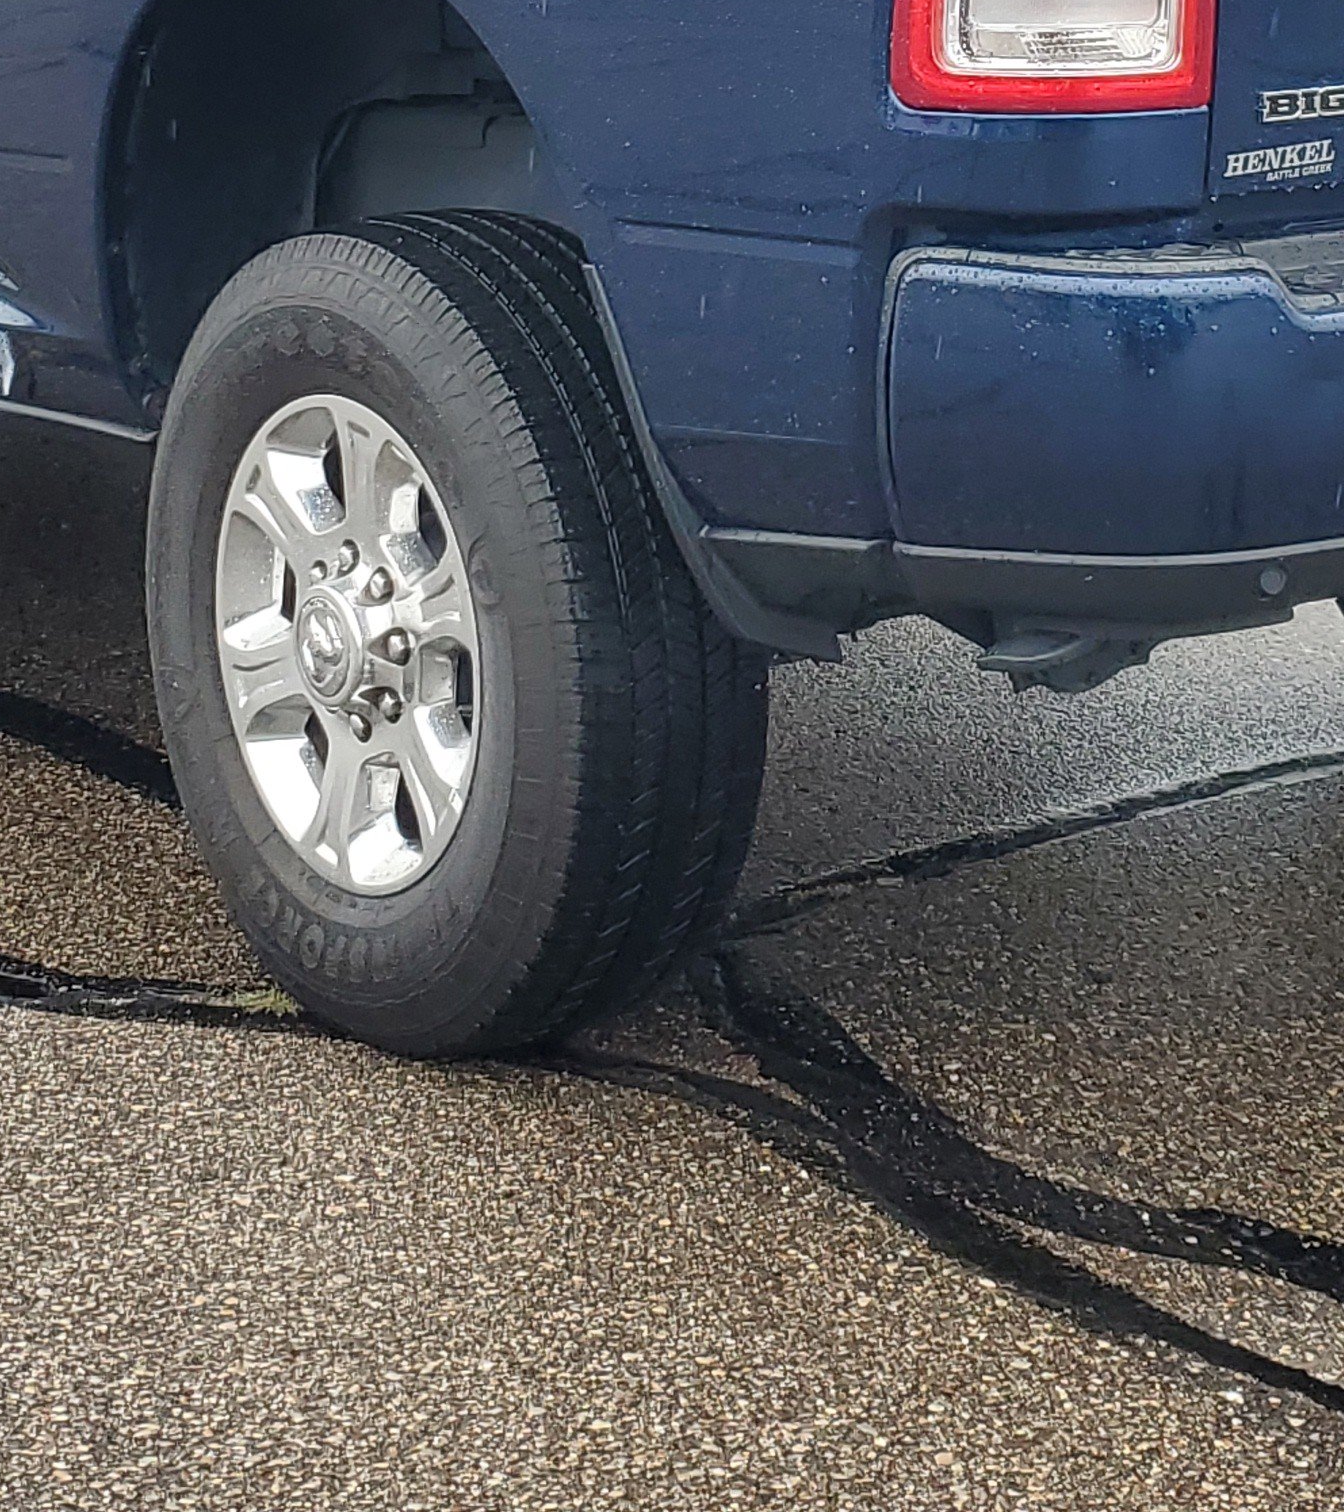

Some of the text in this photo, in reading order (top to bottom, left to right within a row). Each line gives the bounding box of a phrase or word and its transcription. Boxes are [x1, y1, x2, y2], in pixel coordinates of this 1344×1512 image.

[1223, 138, 1336, 178] HENKEL
[1265, 162, 1333, 182] BATTLE CREEK
